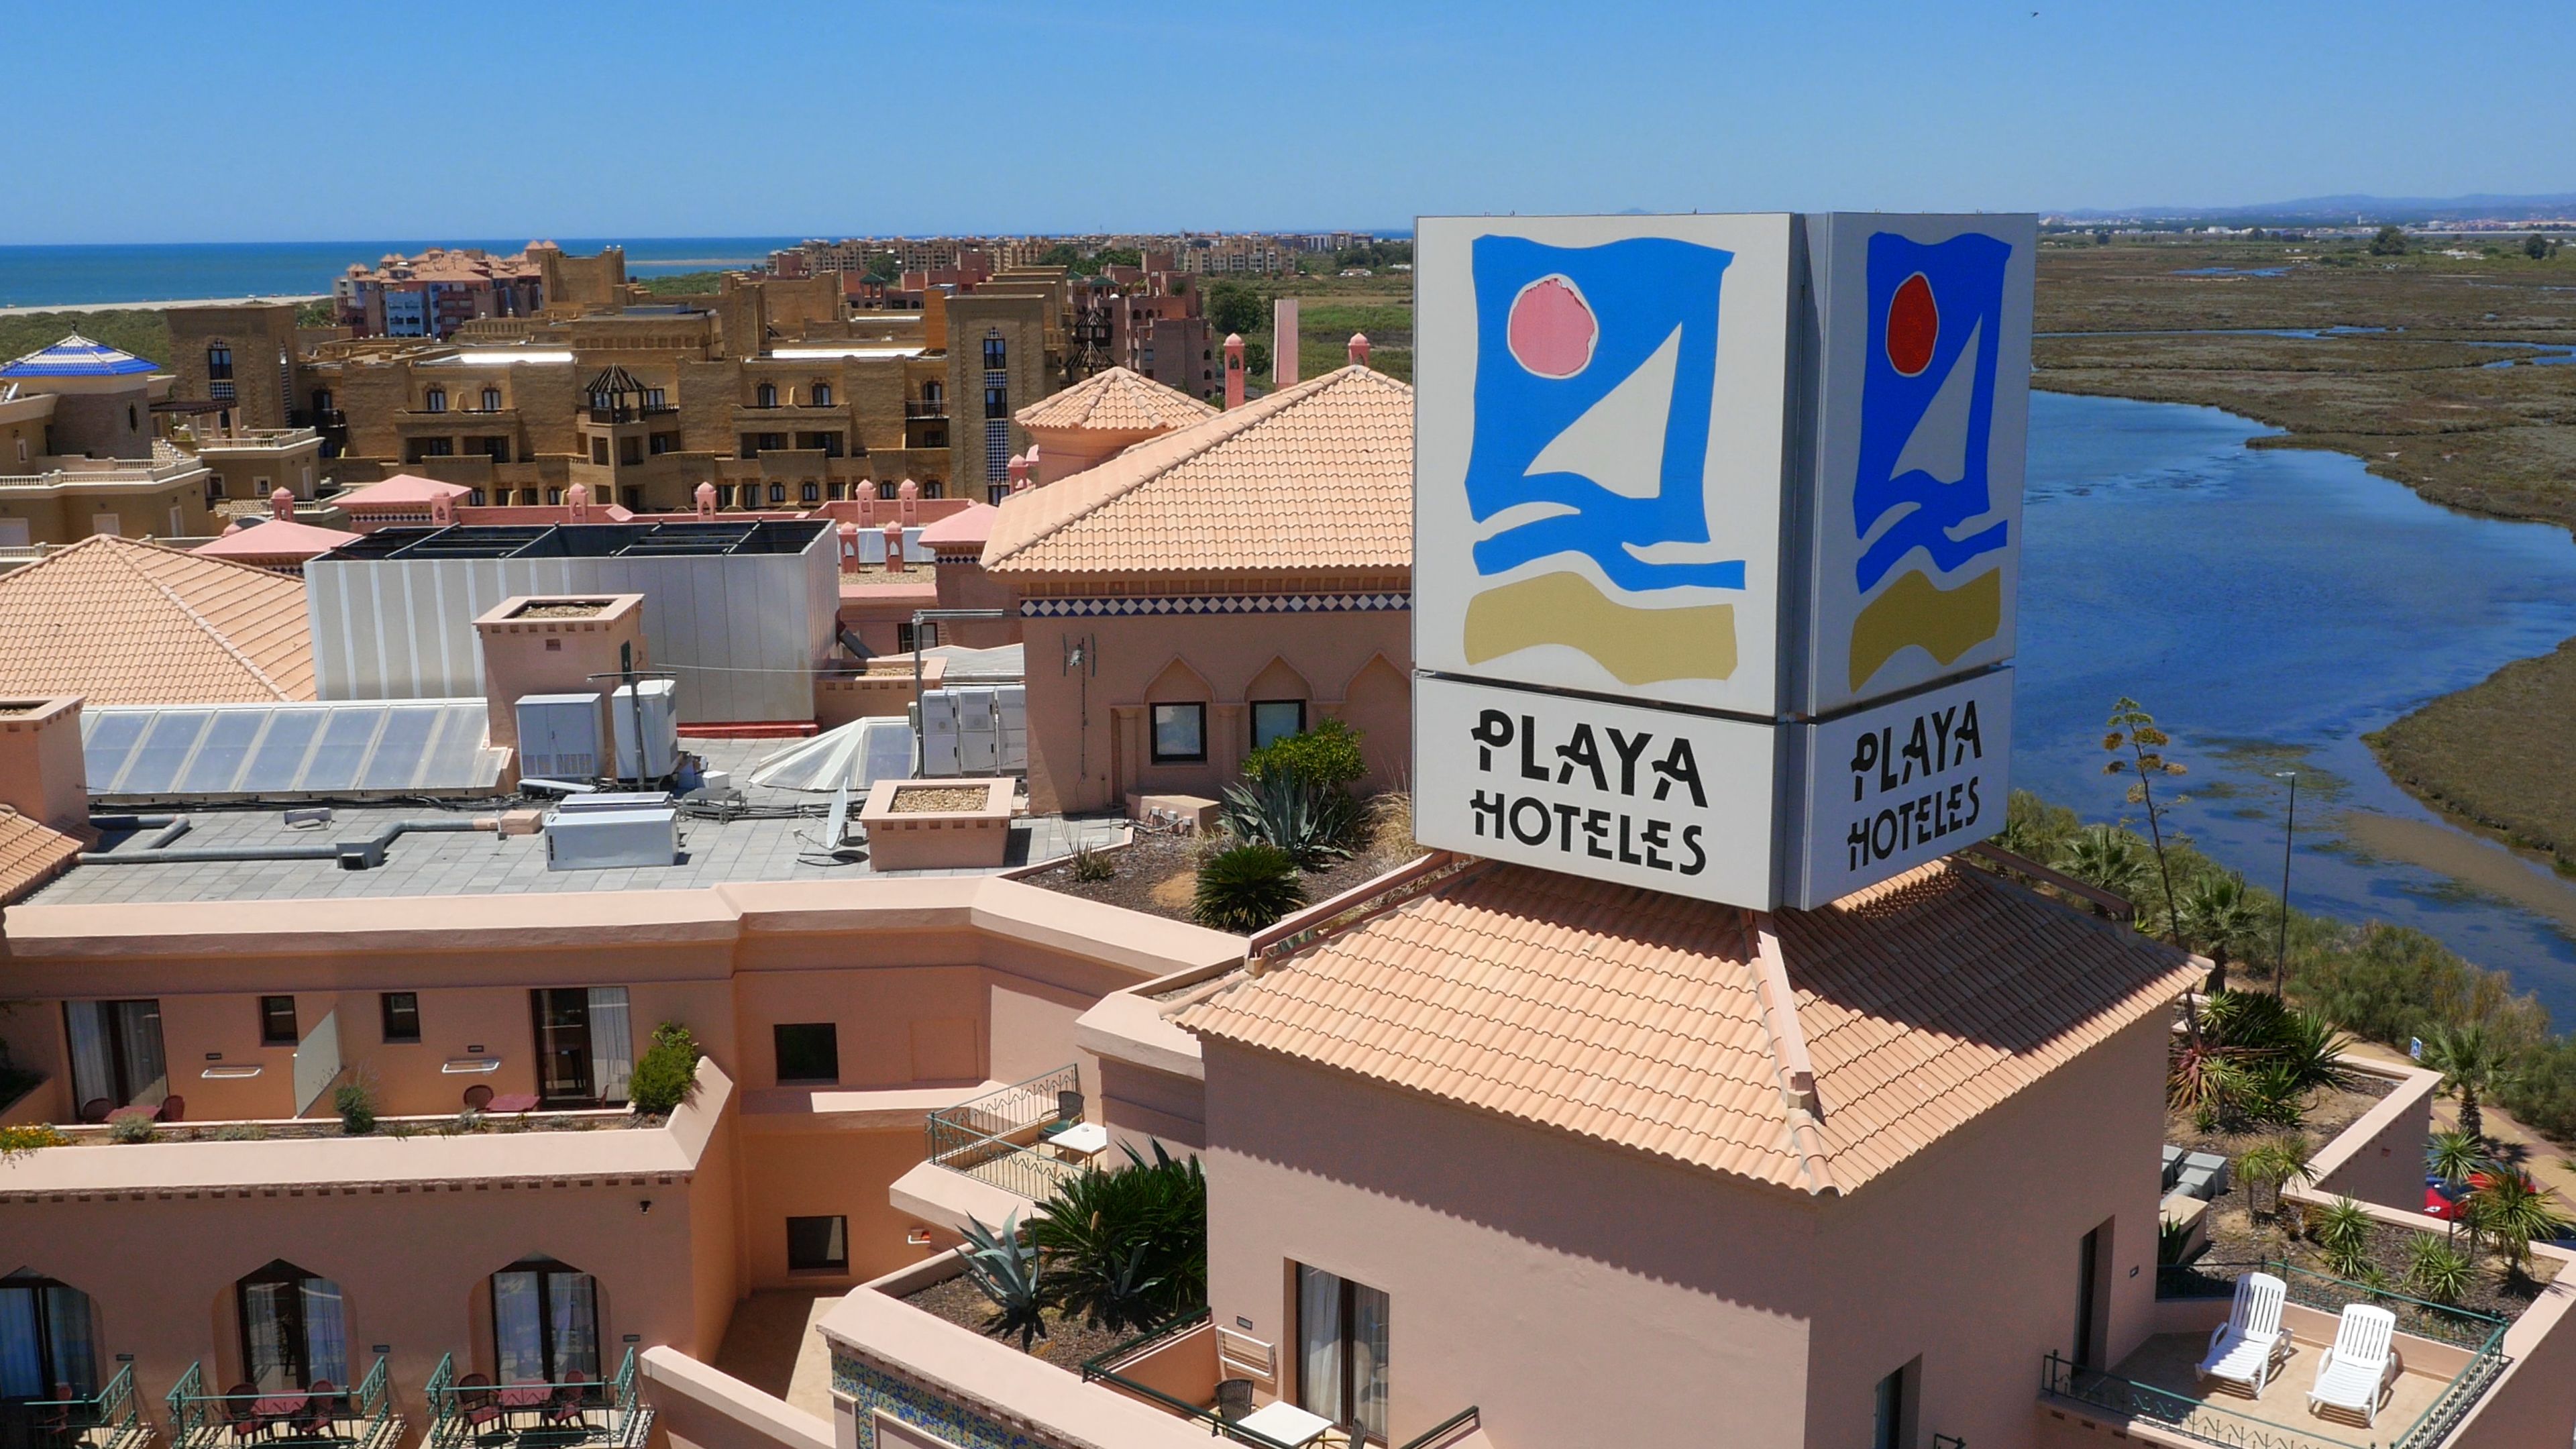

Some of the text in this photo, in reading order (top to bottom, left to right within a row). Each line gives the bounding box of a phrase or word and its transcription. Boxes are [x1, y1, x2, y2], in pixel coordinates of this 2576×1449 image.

[1470, 709, 1709, 808] PLAYA
[1849, 699, 1983, 803] PLAYA
[1469, 789, 1707, 876] HOTELES
[1847, 775, 1981, 872] HOTELES
